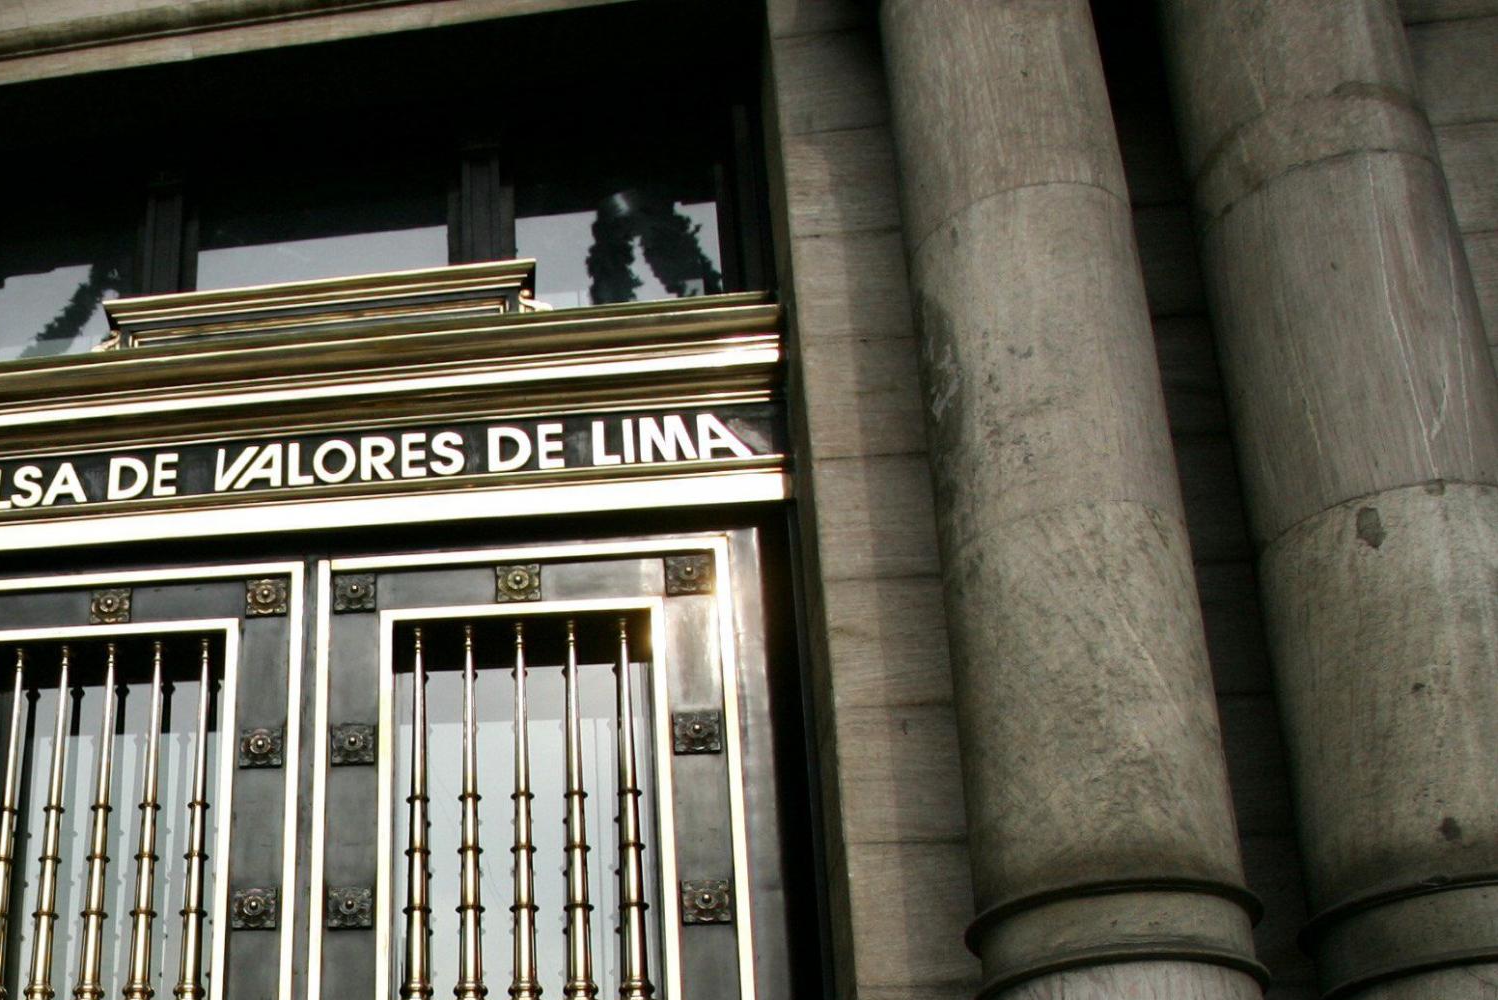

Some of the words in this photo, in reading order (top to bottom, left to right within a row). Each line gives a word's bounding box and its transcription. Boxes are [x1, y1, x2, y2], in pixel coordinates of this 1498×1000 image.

[107, 453, 179, 500] DE
[214, 431, 465, 492] VALORES
[487, 423, 565, 472] DE
[592, 413, 754, 466] LIMA
